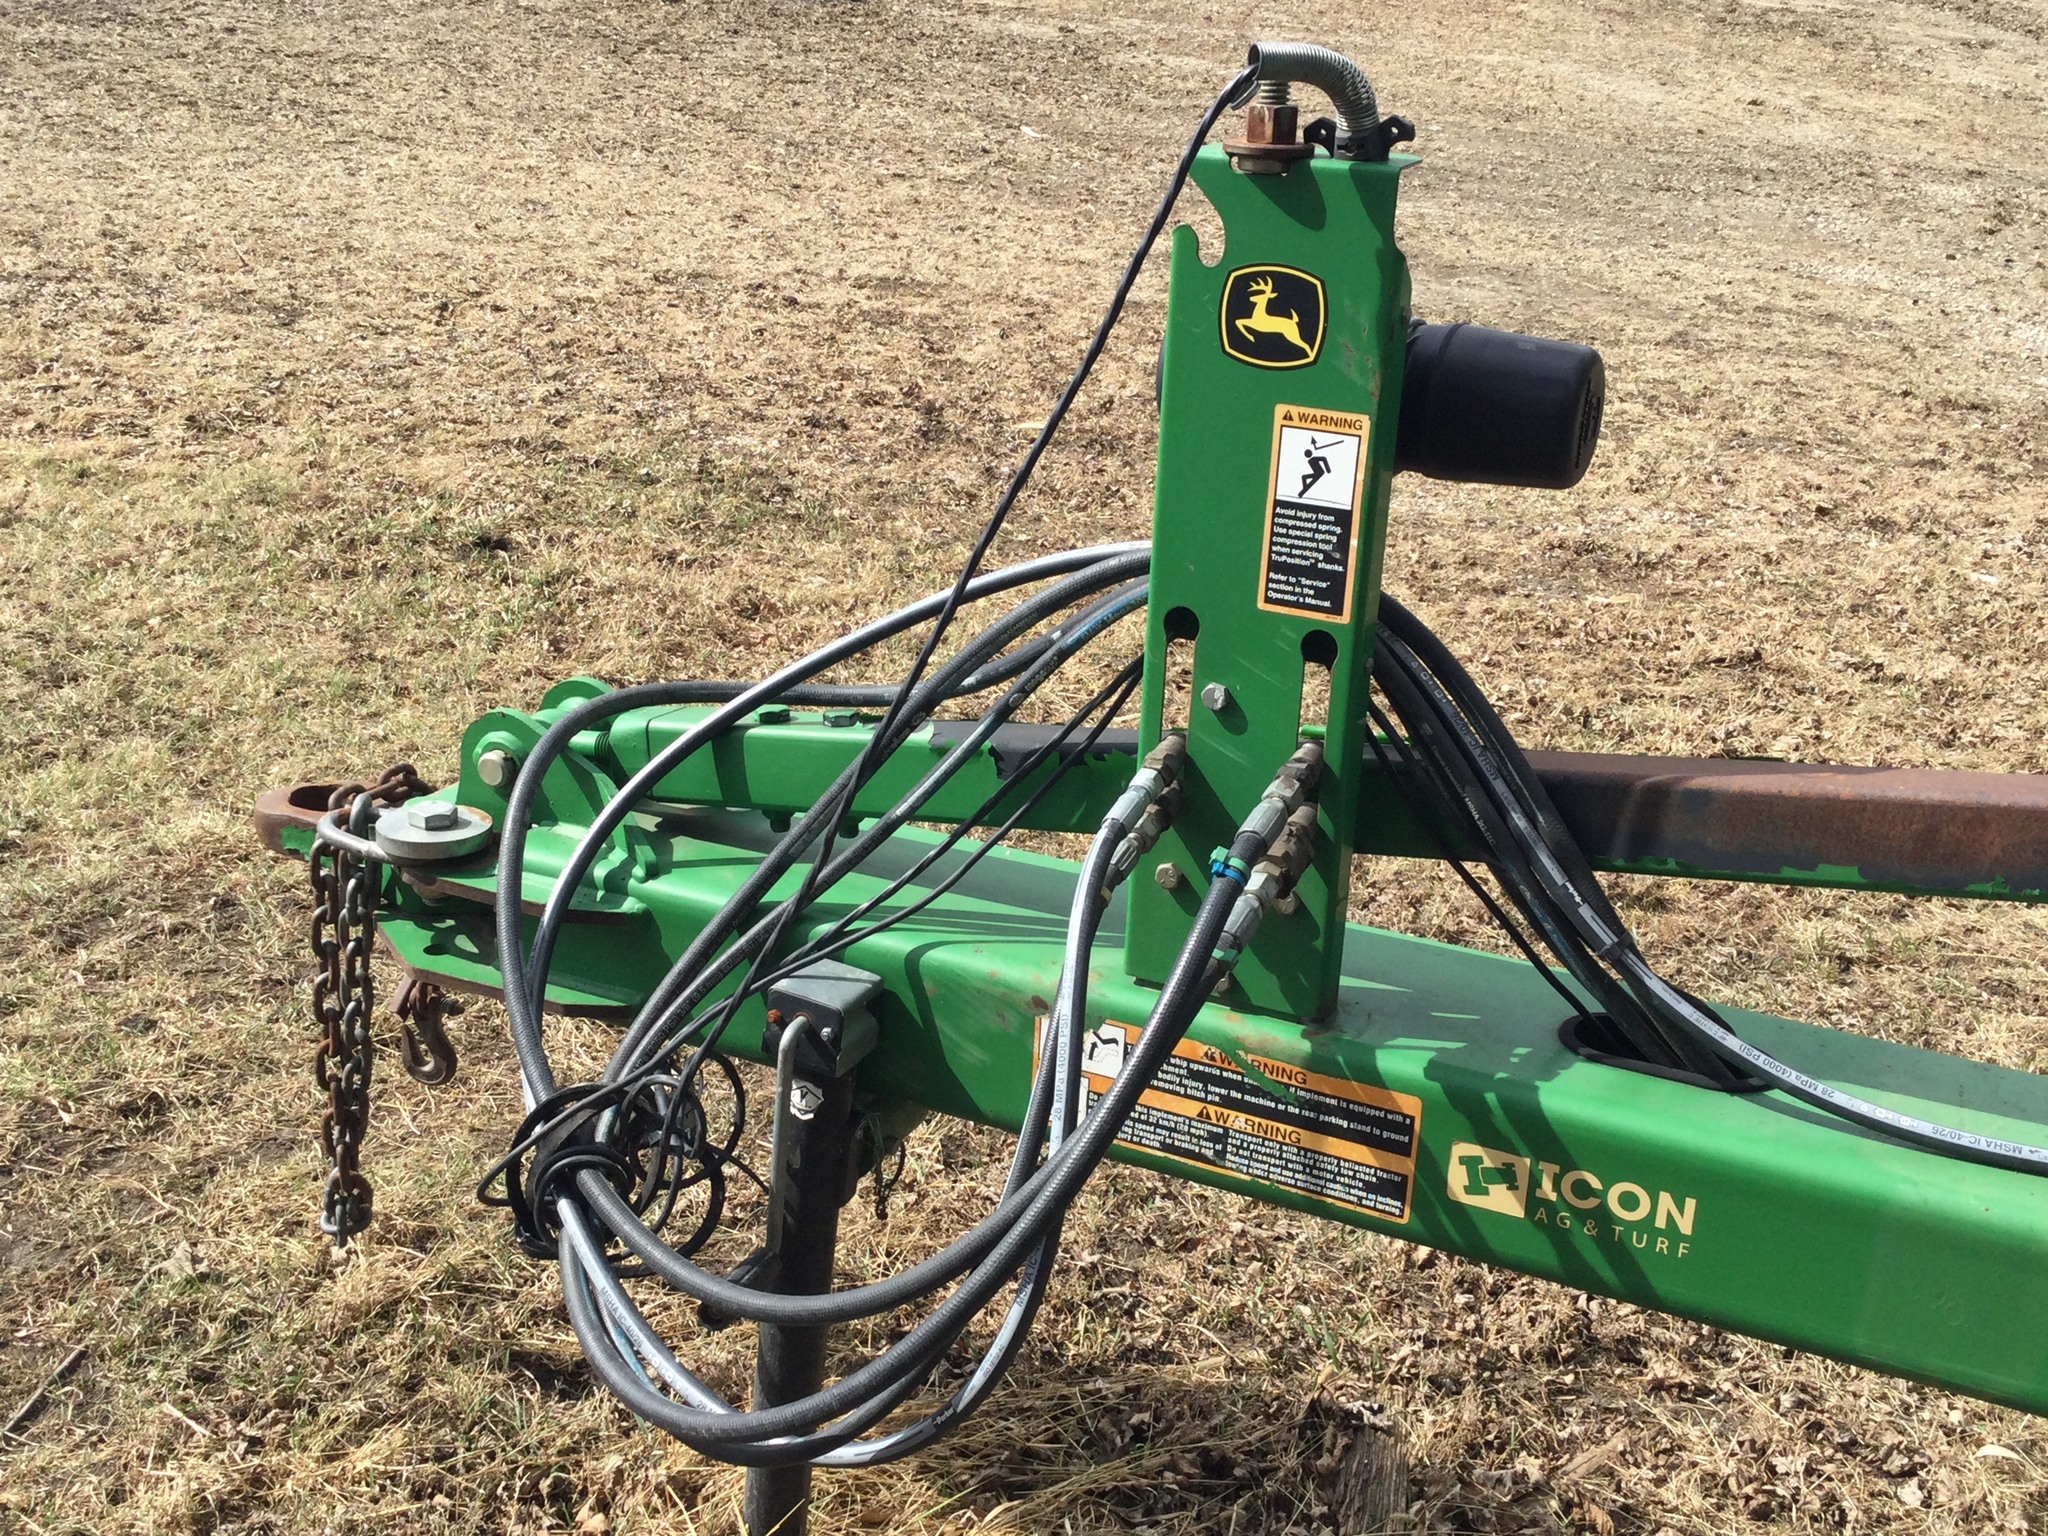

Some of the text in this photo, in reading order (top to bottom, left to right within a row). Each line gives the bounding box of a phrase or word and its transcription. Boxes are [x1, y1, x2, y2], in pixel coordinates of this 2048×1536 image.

[1298, 412, 1362, 430] WARNING
[1274, 517, 1342, 534] compressed spring.
[1275, 507, 1335, 521] Avoid injury from
[1272, 536, 1332, 550] compression tool
[1273, 526, 1337, 543] Use special spring
[1272, 545, 1323, 560] when servicing
[1318, 562, 1345, 572] shanks.
[1268, 582, 1293, 591] section
[1303, 587, 1314, 595] the
[1269, 572, 1288, 581] Refer
[1298, 577, 1330, 588] "Service"
[1267, 591, 1332, 607] Operator's Manual.
[1474, 748, 1501, 782] MSHA
[1738, 1044, 1760, 1062] PSI)
[1053, 1014, 1070, 1121] 28 MPa (4000 PSI)
[1219, 1051, 1307, 1085] WRNING
[1762, 1056, 1794, 1080] (4000
[1170, 1057, 1187, 1068] whip
[1189, 1060, 1221, 1075] upwards
[1222, 1070, 1242, 1082] when
[1297, 1088, 1338, 1106] implement
[1340, 1100, 1347, 1108] is
[1349, 1102, 1385, 1118] equipped
[1387, 1110, 1403, 1122] with
[1795, 1073, 1819, 1093] MPa
[1820, 1085, 1835, 1099] 28
[1187, 1088, 1205, 1098] hitch
[1207, 1092, 1222, 1103] pin.
[1135, 1104, 1148, 1114] this
[1149, 1107, 1190, 1124] implement's
[1191, 1117, 1223, 1133] maximum
[1158, 1072, 1181, 1085] bodily
[1208, 1084, 1228, 1095] lower
[1230, 1088, 1242, 1099] the
[1244, 1093, 1275, 1108] machine
[1288, 1103, 1299, 1114] the
[1319, 1113, 1348, 1129] parking
[1350, 1121, 1370, 1133] stand
[1372, 1126, 1380, 1135] to
[1382, 1129, 1409, 1143] ground
[1148, 1114, 1157, 1124] 32
[1159, 1116, 1175, 1128] km/h
[1134, 1129, 1163, 1143] transport
[1165, 1137, 1173, 1145] or
[1174, 1139, 1199, 1153] braking
[1201, 1145, 1213, 1155] and
[1135, 1137, 1142, 1145] or
[1144, 1139, 1162, 1149] death.
[1138, 1123, 1153, 1134] speed
[1155, 1127, 1169, 1138] may
[1171, 1130, 1190, 1142] result
[1200, 1137, 1213, 1148] loss
[1215, 1142, 1222, 1150] of
[1931, 1125, 1983, 1147] IC-40/26
[1985, 1138, 2023, 1155] MSHA
[1228, 1138, 1241, 1148] and
[1250, 1141, 1281, 1160] properly
[1282, 1149, 1313, 1166] attached
[1316, 1158, 1339, 1173] safety
[1341, 1164, 1354, 1175] tow
[1356, 1169, 1379, 1184] chain.
[1229, 1130, 1262, 1146] Transport
[1265, 1138, 1285, 1150] only
[1287, 1143, 1298, 1153] with
[1307, 1148, 1338, 1165] properly
[1340, 1156, 1375, 1175] ballasted
[1377, 1167, 1402, 1182] tractor
[1226, 1153, 1248, 1165] Reduce
[1251, 1159, 1268, 1172] speed
[1270, 1164, 1281, 1174] and
[1283, 1167, 1293, 1177] use
[1295, 1170, 1324, 1186] additional
[1351, 1187, 1367, 1198] when
[1238, 1148, 1250, 1157] not
[1252, 1151, 1286, 1167] transport
[1288, 1161, 1303, 1171] with
[1313, 1166, 1334, 1178] motor
[1335, 1173, 1365, 1188] vehicle.
[1269, 1172, 1295, 1187] adverse
[1297, 1179, 1322, 1193] surface
[1362, 1197, 1374, 1207] and
[1376, 1201, 1402, 1216] turning.
[1535, 1160, 1697, 1236] ICON
[1534, 1207, 1690, 1258] AG & TURF
[596, 1285, 708, 1414] MSHA IC-40/26 28
[933, 1405, 957, 1425] Parker
[1011, 1269, 1036, 1307] MSHA
